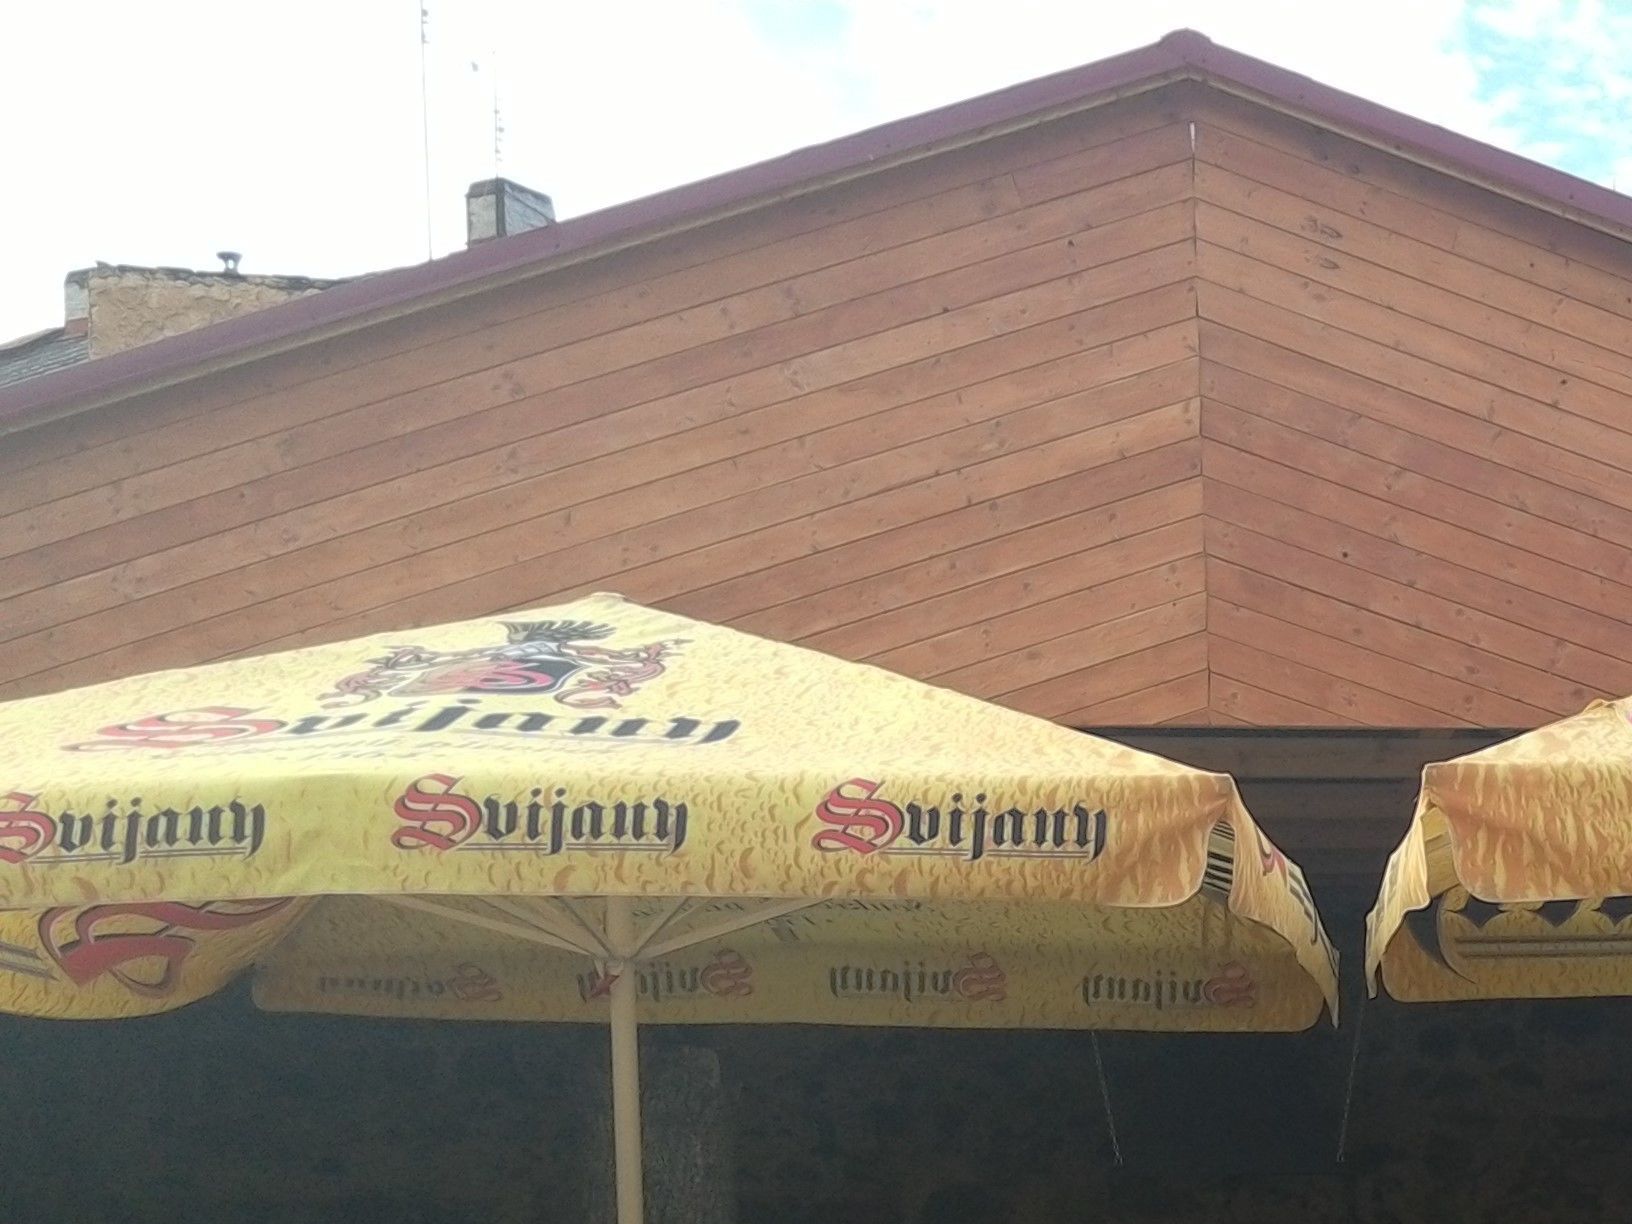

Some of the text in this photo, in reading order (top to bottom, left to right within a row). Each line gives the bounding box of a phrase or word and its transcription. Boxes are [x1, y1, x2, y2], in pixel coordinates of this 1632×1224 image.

[60, 698, 741, 751] Svijany
[392, 773, 687, 855] Svijany
[811, 777, 1106, 863] Svijany
